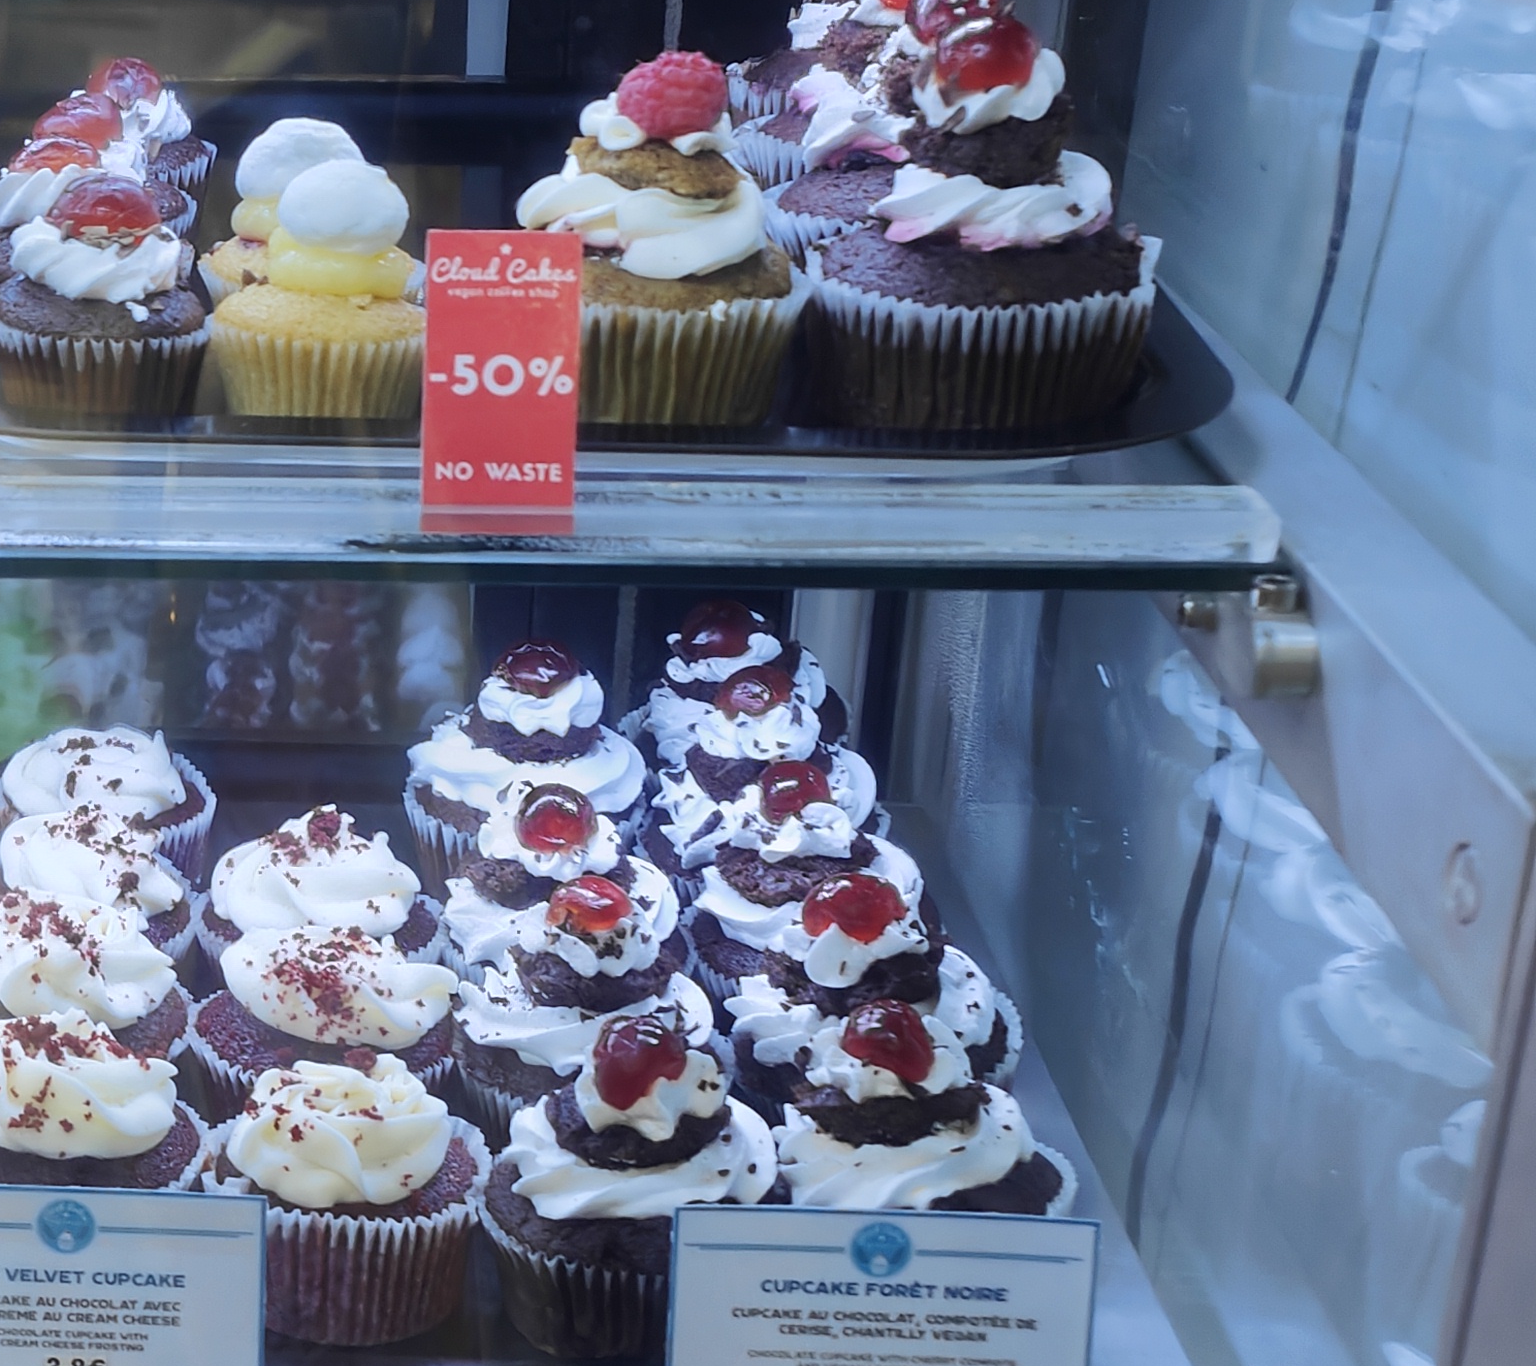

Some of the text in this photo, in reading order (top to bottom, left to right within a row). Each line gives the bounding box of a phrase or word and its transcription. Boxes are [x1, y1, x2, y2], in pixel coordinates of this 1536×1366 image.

[431, 256, 577, 283] Cloud Cakes
[429, 354, 574, 396] -50%
[434, 461, 562, 482] NO WASTE
[5, 1268, 84, 1285] VELVET
[92, 1272, 185, 1288] CUPCAKE
[761, 1280, 1008, 1302] CUPCAKE FORÊT NOIRE
[36, 1297, 56, 1307] AU
[60, 1298, 137, 1310] CHOCOLAT
[143, 1302, 181, 1312] AVEC
[43, 1312, 61, 1322] AU
[67, 1313, 118, 1324] CREAM
[122, 1315, 180, 1326] CHEESE
[732, 1307, 802, 1319] CUPCAKE
[808, 1310, 828, 1321] AU
[834, 1311, 920, 1327] CHOCOLAT,
[1016, 1319, 1037, 1331] DE
[65, 1330, 116, 1340] CUPCAKE
[120, 1333, 148, 1341] WITH
[779, 1324, 839, 1339] CERISE,
[842, 1326, 926, 1339] CHANTILLY
[0, 1339, 144, 1351] CREAM CHEESE FROSTING
